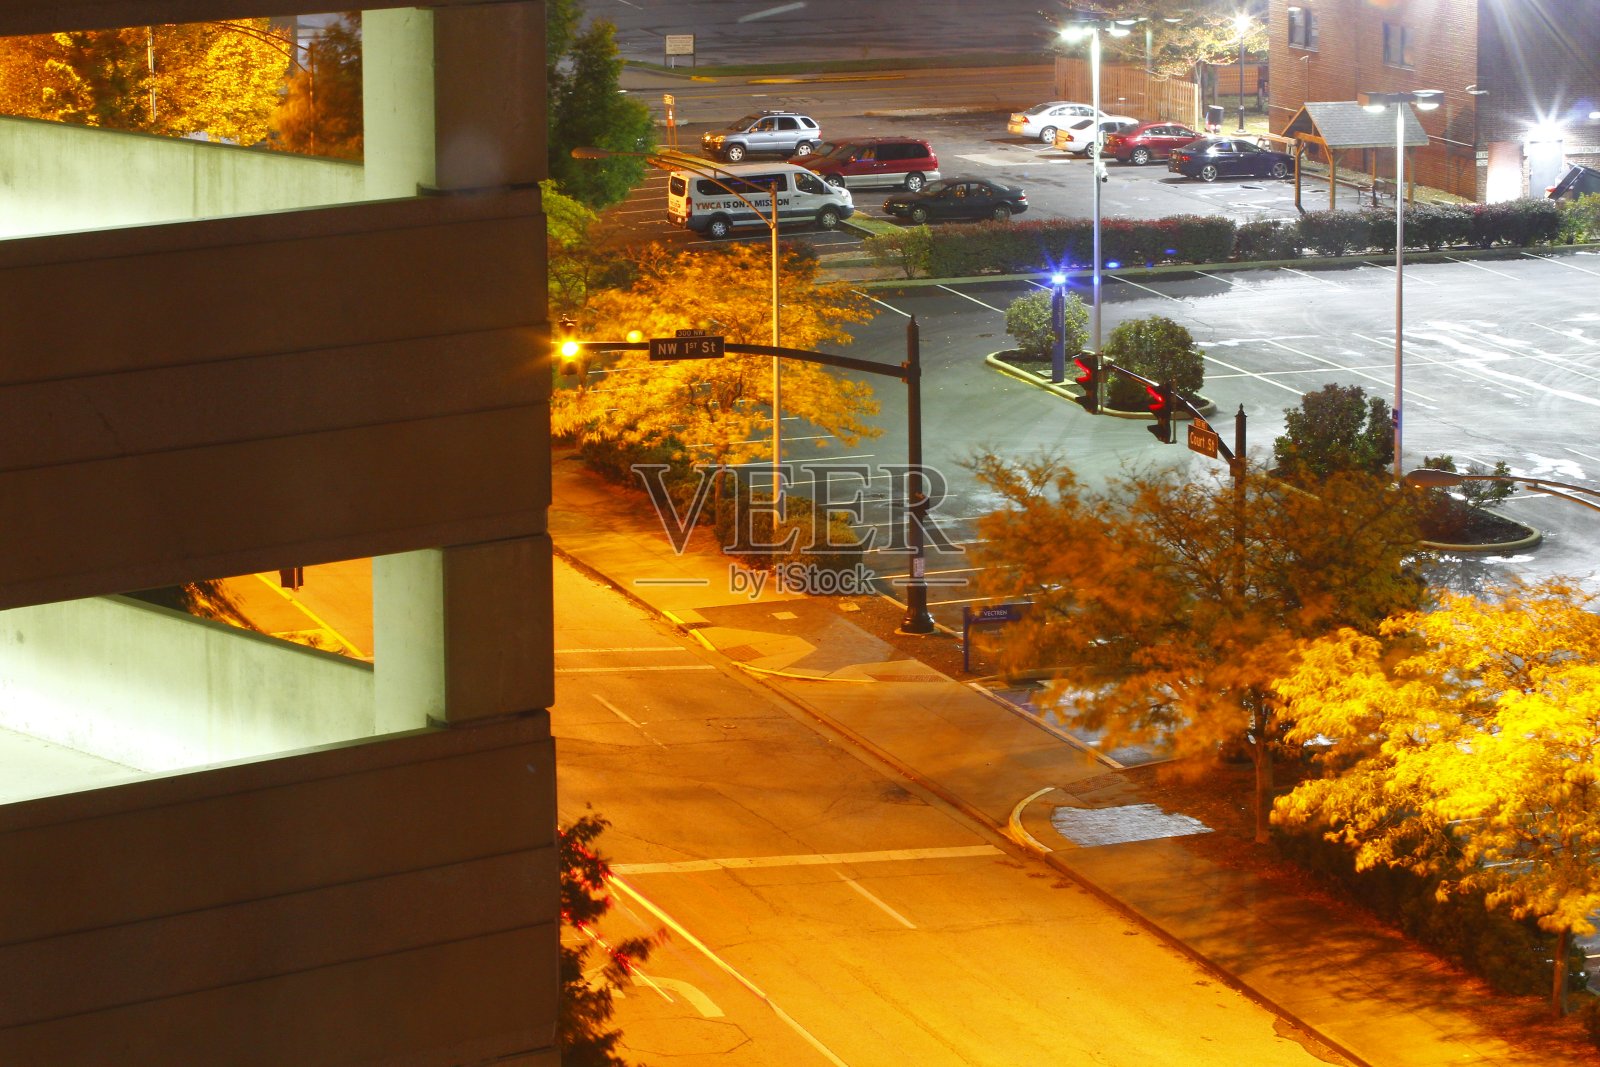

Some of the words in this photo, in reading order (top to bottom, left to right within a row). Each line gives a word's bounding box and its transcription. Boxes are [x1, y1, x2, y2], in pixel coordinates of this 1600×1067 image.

[695, 202, 722, 210] YWCA
[723, 201, 731, 209] IS
[732, 200, 745, 208] ON
[754, 198, 790, 208] MISSON
[658, 343, 677, 355] NW
[702, 341, 716, 353] St
[1190, 431, 1205, 449] Court
[1207, 438, 1215, 452] St
